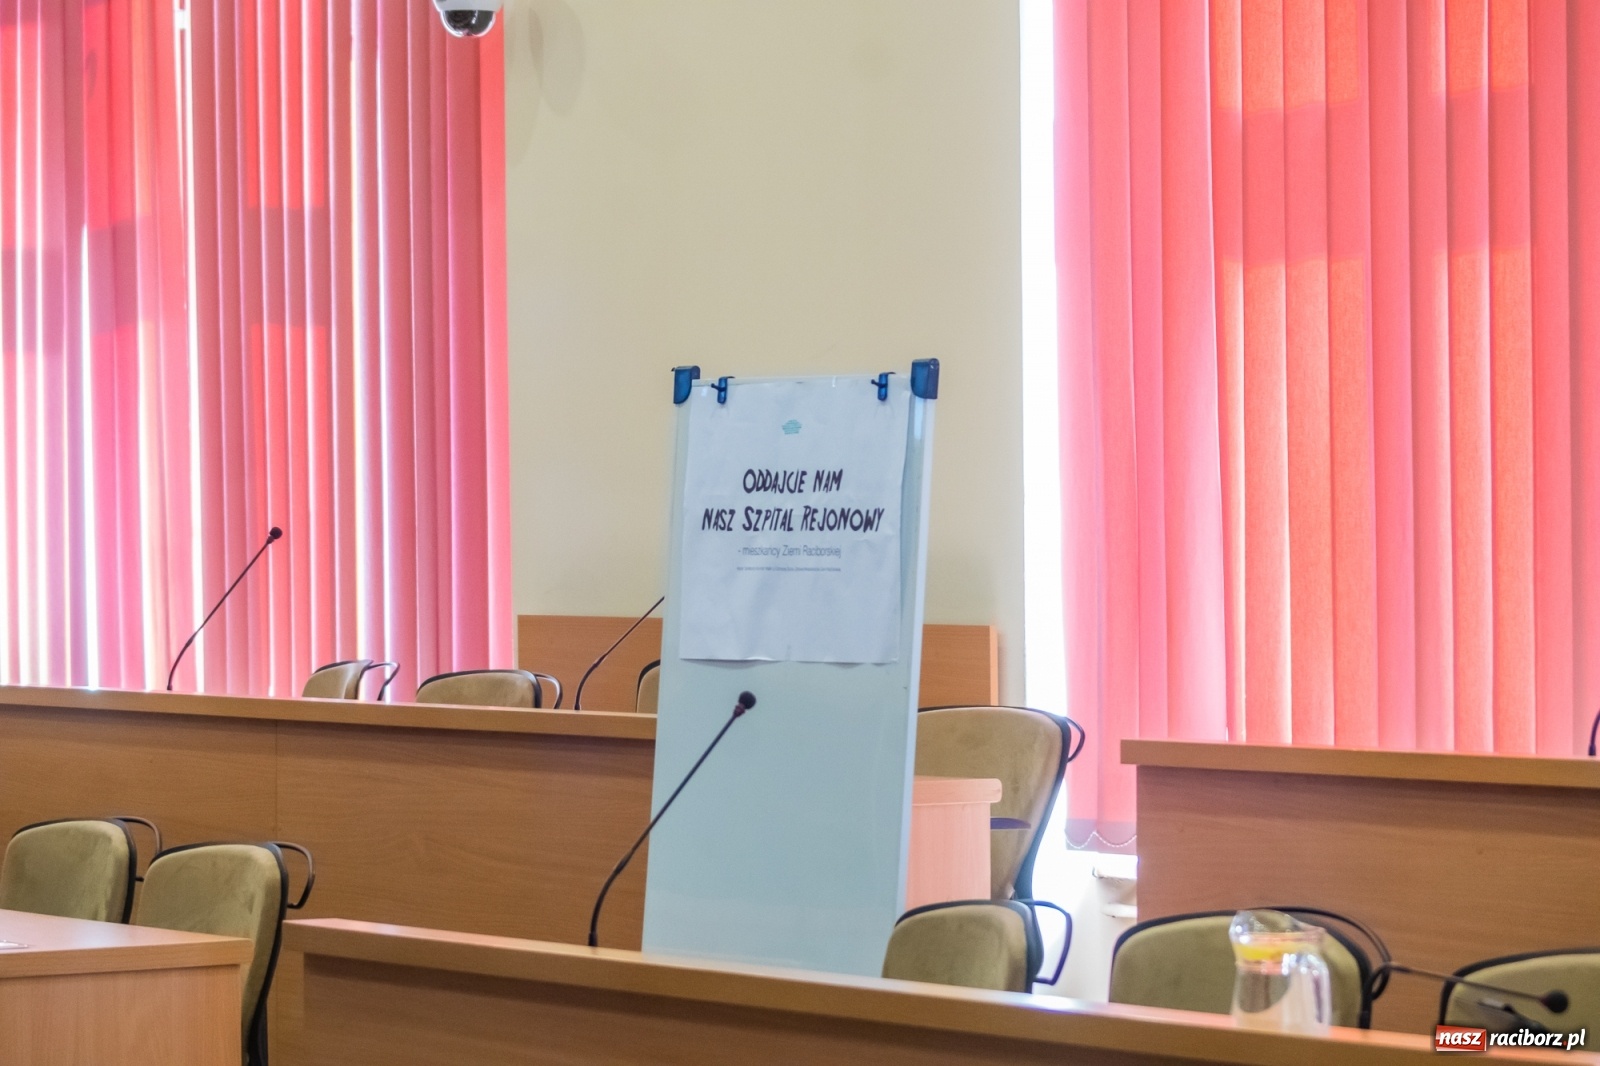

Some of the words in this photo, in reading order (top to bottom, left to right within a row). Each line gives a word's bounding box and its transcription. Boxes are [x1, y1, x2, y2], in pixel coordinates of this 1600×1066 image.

[743, 468, 807, 494] ODDAJCIE
[812, 468, 843, 493] NAM
[701, 508, 736, 531] NASZ
[742, 506, 794, 531] SZPITAL
[800, 505, 885, 533] REJONOWY
